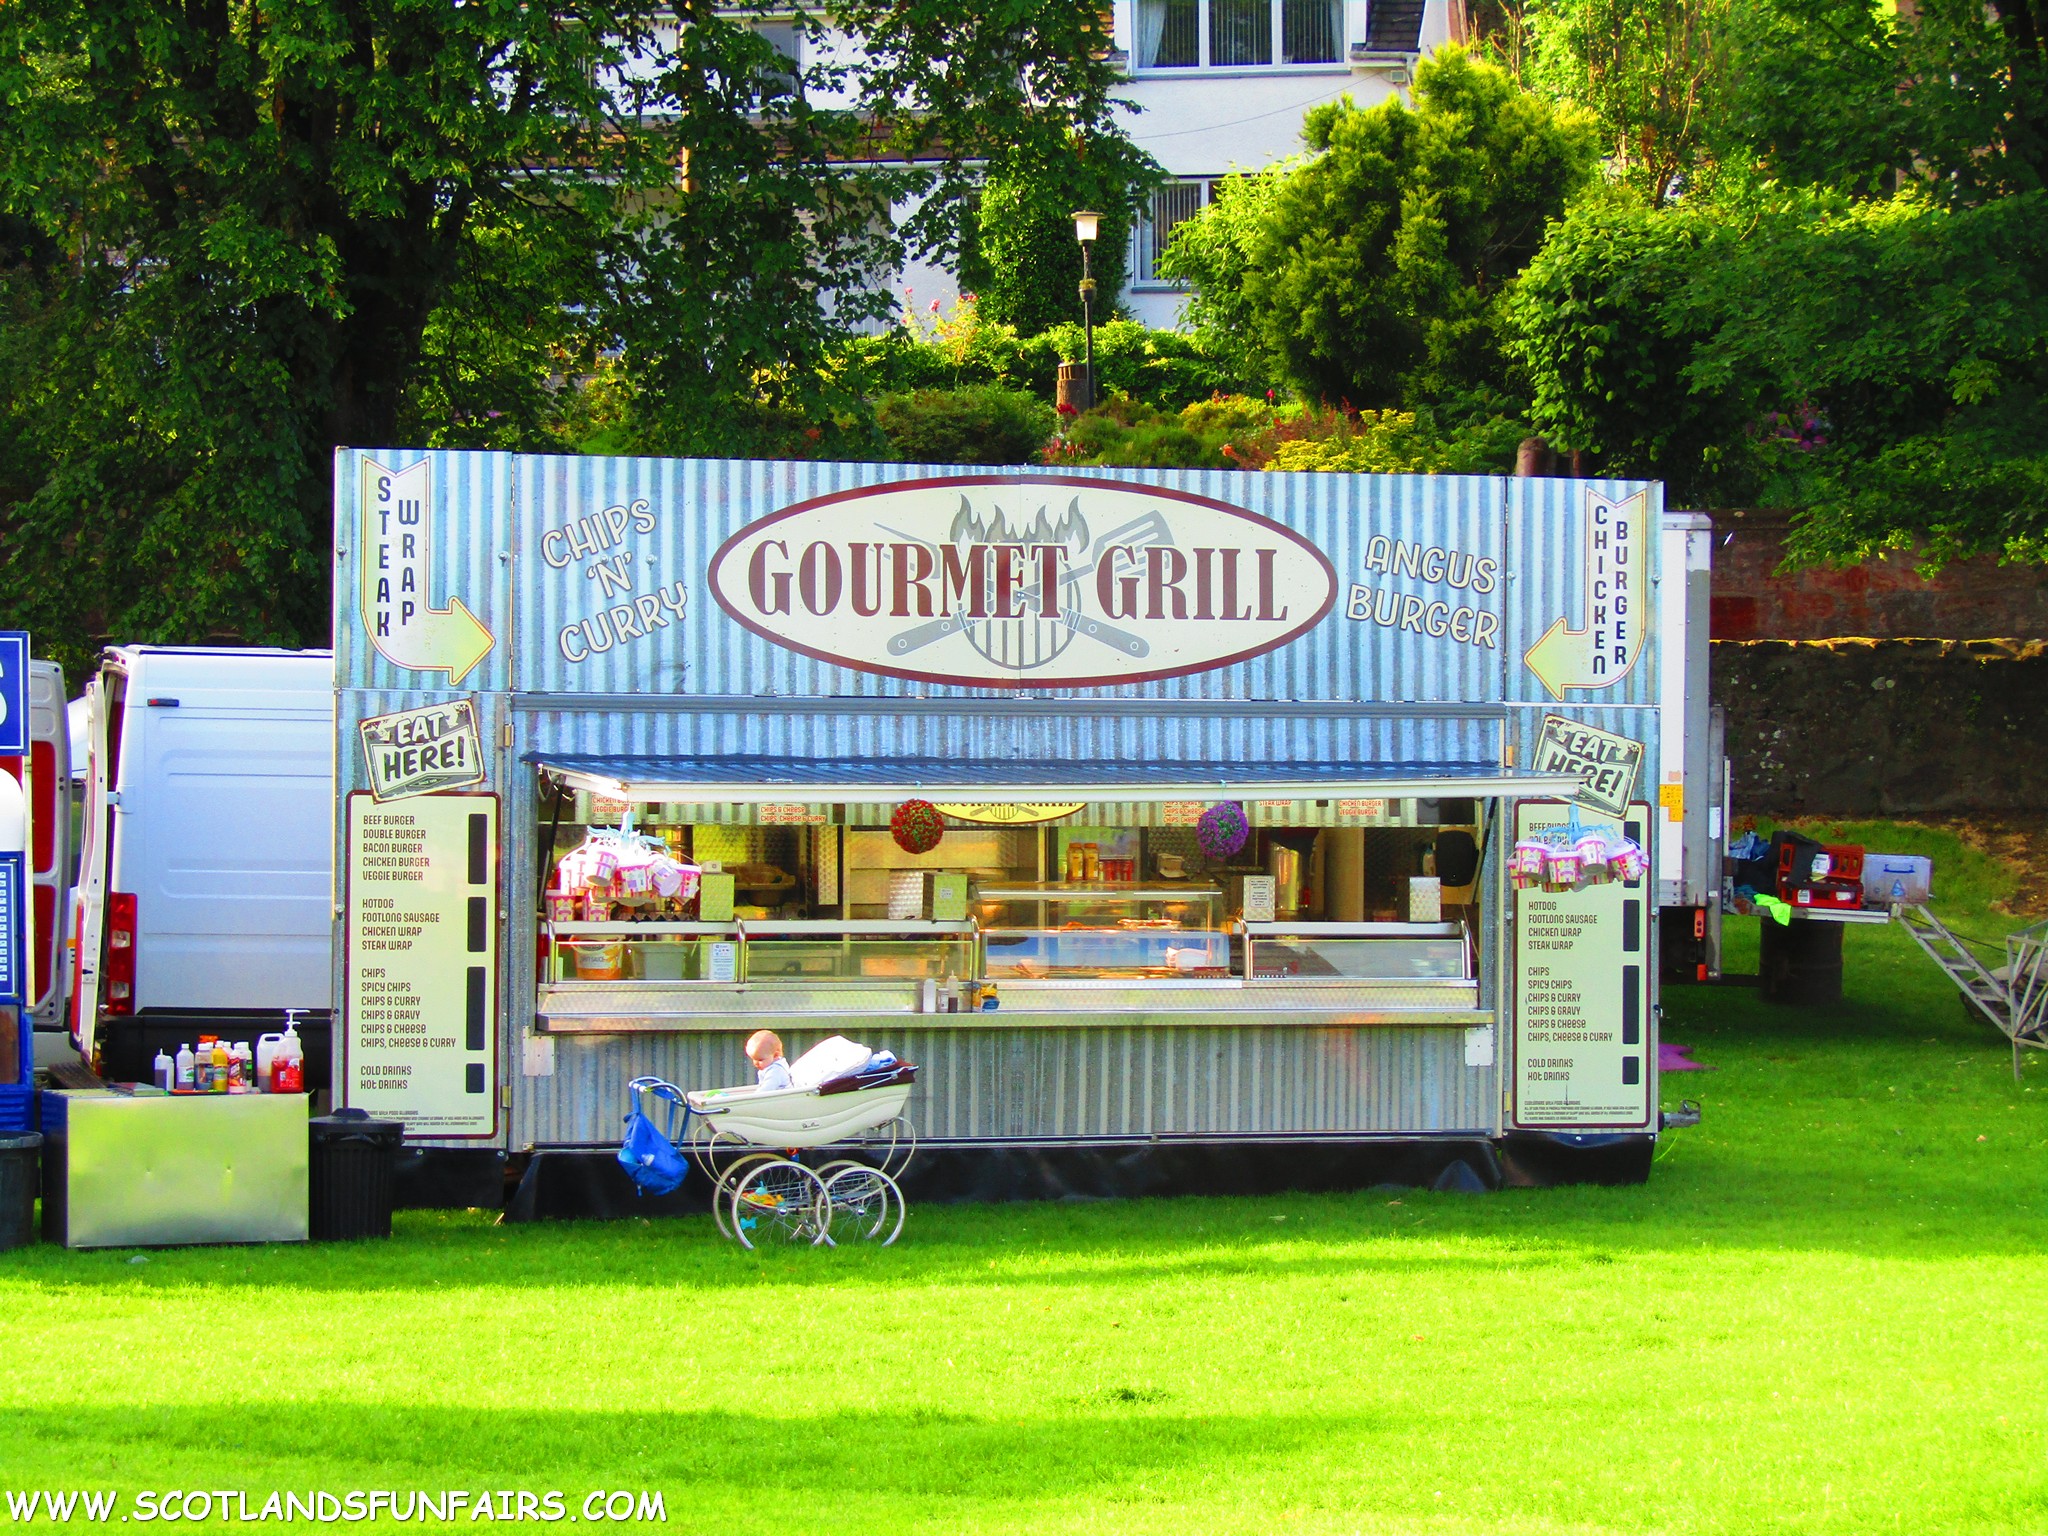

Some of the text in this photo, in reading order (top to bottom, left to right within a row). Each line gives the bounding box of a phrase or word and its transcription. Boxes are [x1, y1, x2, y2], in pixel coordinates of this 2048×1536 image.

[542, 499, 656, 569] CHIPS
[376, 476, 391, 637] STEAK
[398, 499, 419, 626] WRAP
[1365, 534, 1498, 594] ANGUS
[748, 540, 1289, 622] GOURMET GRILL
[1592, 505, 1608, 675] CHICKEN
[1614, 521, 1629, 665] BURGER
[1346, 583, 1499, 649] BURGER
[559, 581, 688, 663] CURRY
[396, 711, 445, 747] EAT
[1569, 731, 1617, 763] EAT
[383, 736, 465, 782] HERE!
[363, 815, 415, 825] BEEF BURGER
[363, 829, 426, 839] DOUBLE BURGER
[363, 843, 423, 853] BACON BURGER
[363, 857, 430, 867] CHICKEN BURGER
[363, 871, 423, 881] VEGGIE BURGER
[363, 899, 394, 908] HOTDOG
[1528, 902, 1557, 910] HOTDOG
[362, 913, 440, 922] FOOTLONG SAUSAGE
[1528, 915, 1598, 924] FOOTLONG SAUSAGE
[362, 927, 422, 936] CHICKEN WRAP
[1528, 928, 1582, 936] CHICKEN WRAP
[362, 941, 413, 950] STEAK WRAP
[1528, 941, 1573, 950] STEAK WRAP
[362, 968, 386, 978] CHIPS
[1528, 967, 1550, 976] CHIPS
[362, 982, 411, 992] SPICY CHIPS
[1528, 980, 1572, 990] SPICY CHIPS
[361, 996, 420, 1006] CHIPS & CURRY
[1528, 993, 1581, 1002] CHIPS & CURRY
[361, 1010, 420, 1020] CHIPS & GRAVY
[1528, 1006, 1580, 1015] CHIPS & GRAVY
[1528, 1019, 1549, 1028] CHIPS
[1551, 1019, 1556, 1028] &
[361, 1024, 385, 1034] CHIPS
[387, 1024, 392, 1034] &
[1528, 1032, 1551, 1042] CHIPS,
[1583, 1032, 1588, 1041] &
[1589, 1032, 1612, 1041] CURRY
[361, 1038, 387, 1049] CHIPS,
[423, 1038, 428, 1048] &
[430, 1038, 456, 1048] CURRY
[1528, 1059, 1573, 1068] COLD DRINKS
[360, 1066, 412, 1076] COLD DRINKS
[1544, 1072, 1570, 1081] DRINKS
[378, 1080, 408, 1089] DRINKS
